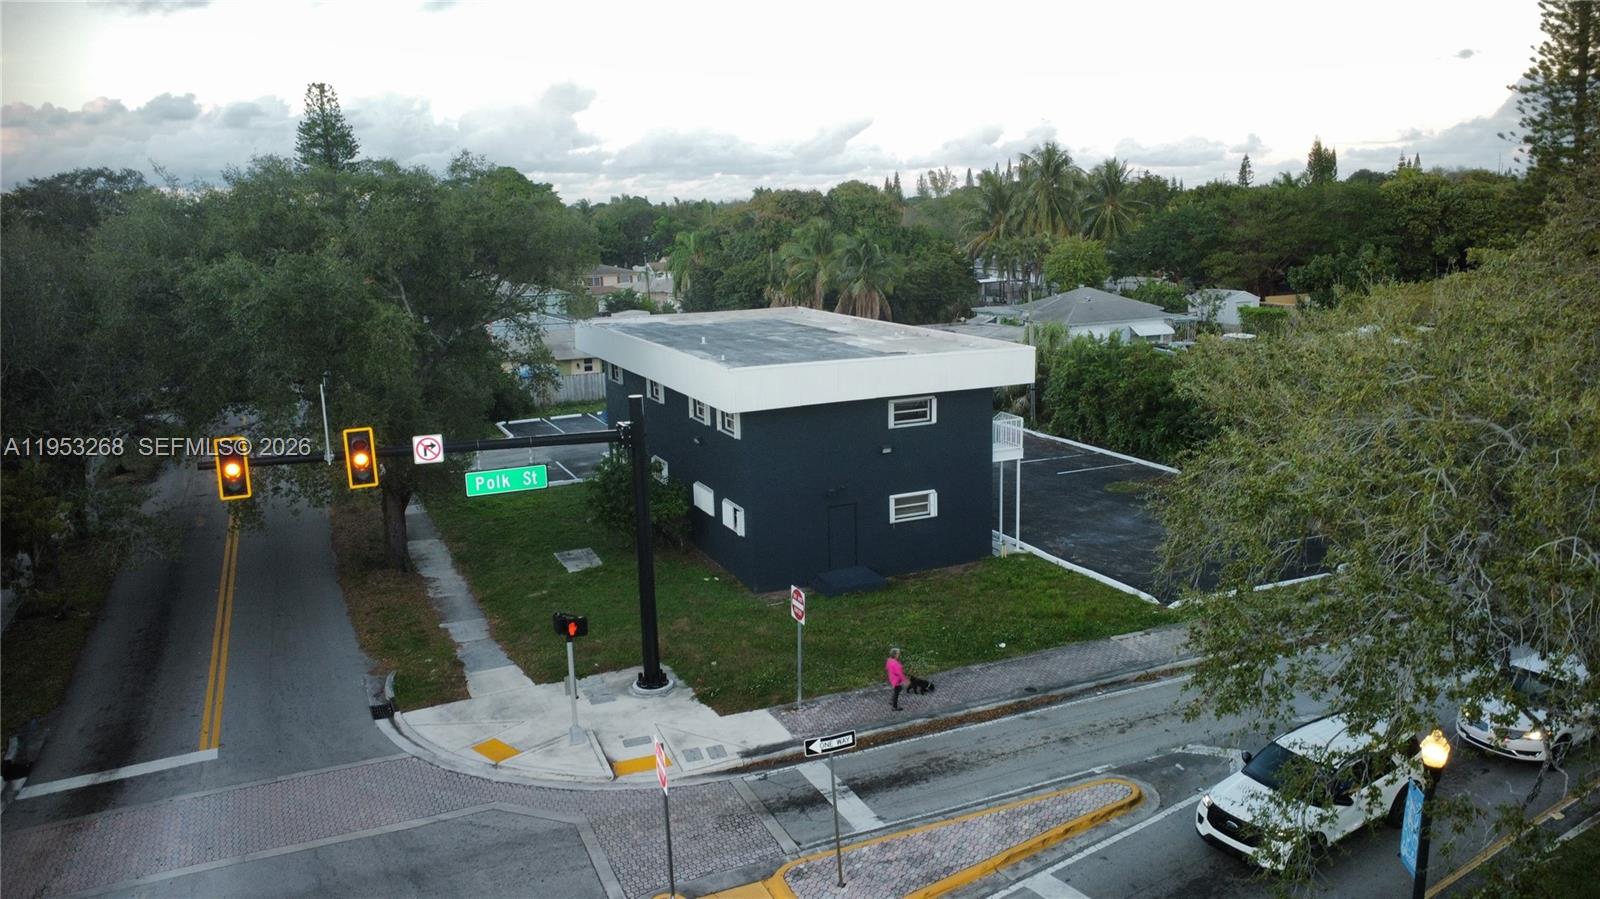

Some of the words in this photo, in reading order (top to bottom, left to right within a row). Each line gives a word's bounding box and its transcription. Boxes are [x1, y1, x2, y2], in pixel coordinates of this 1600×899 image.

[475, 474, 511, 491] Polk
[522, 471, 538, 486] St
[820, 741, 833, 749] ONE
[836, 736, 850, 745] WAY
